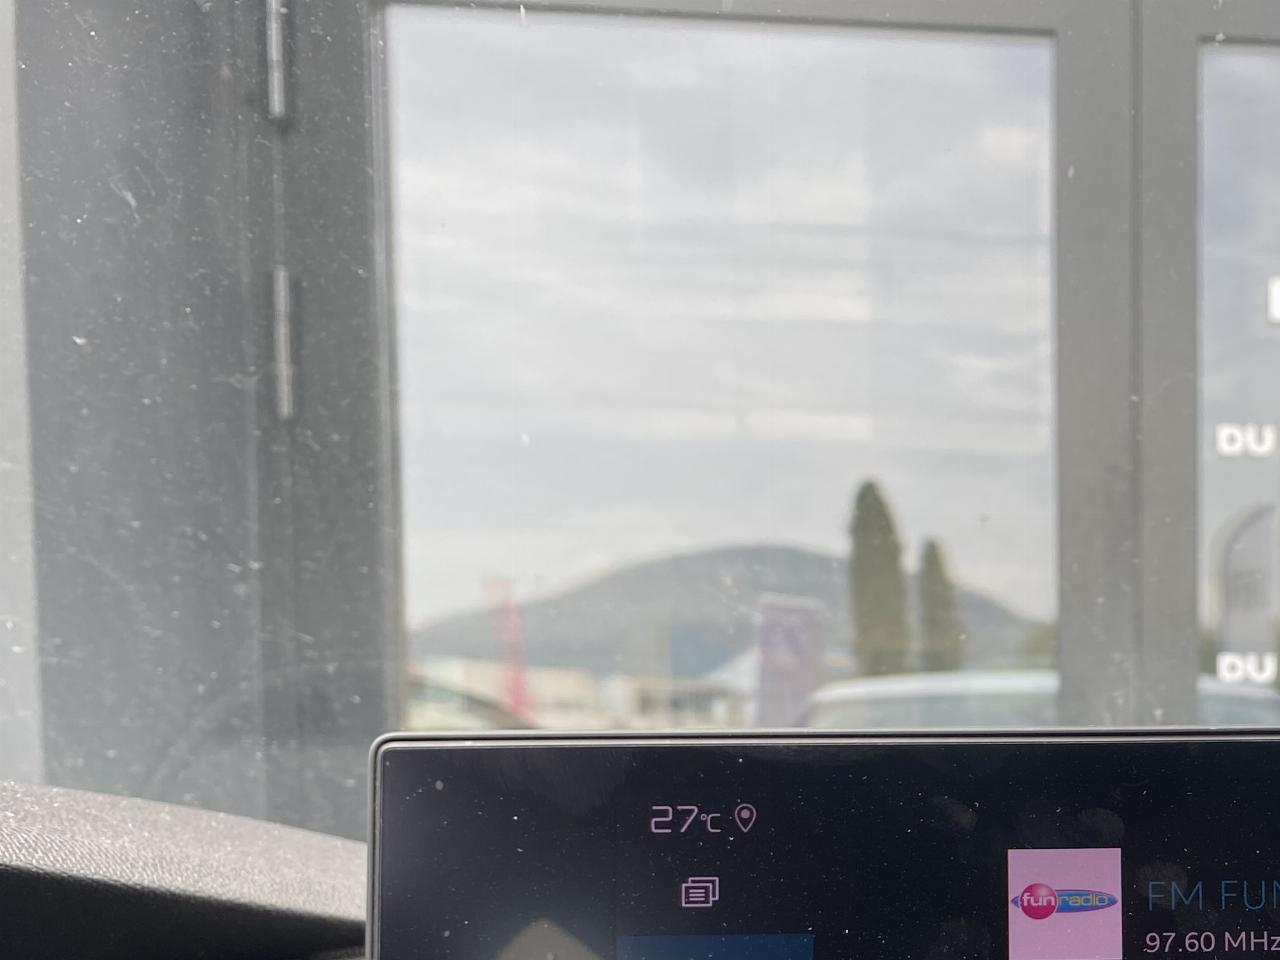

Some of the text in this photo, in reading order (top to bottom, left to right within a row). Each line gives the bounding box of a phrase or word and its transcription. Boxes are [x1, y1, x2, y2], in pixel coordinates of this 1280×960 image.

[1215, 424, 1275, 457] DU
[1215, 653, 1275, 683] DU
[650, 805, 722, 834] 27°C
[1147, 880, 1203, 911] FM
[1145, 931, 1216, 952] 97.60
